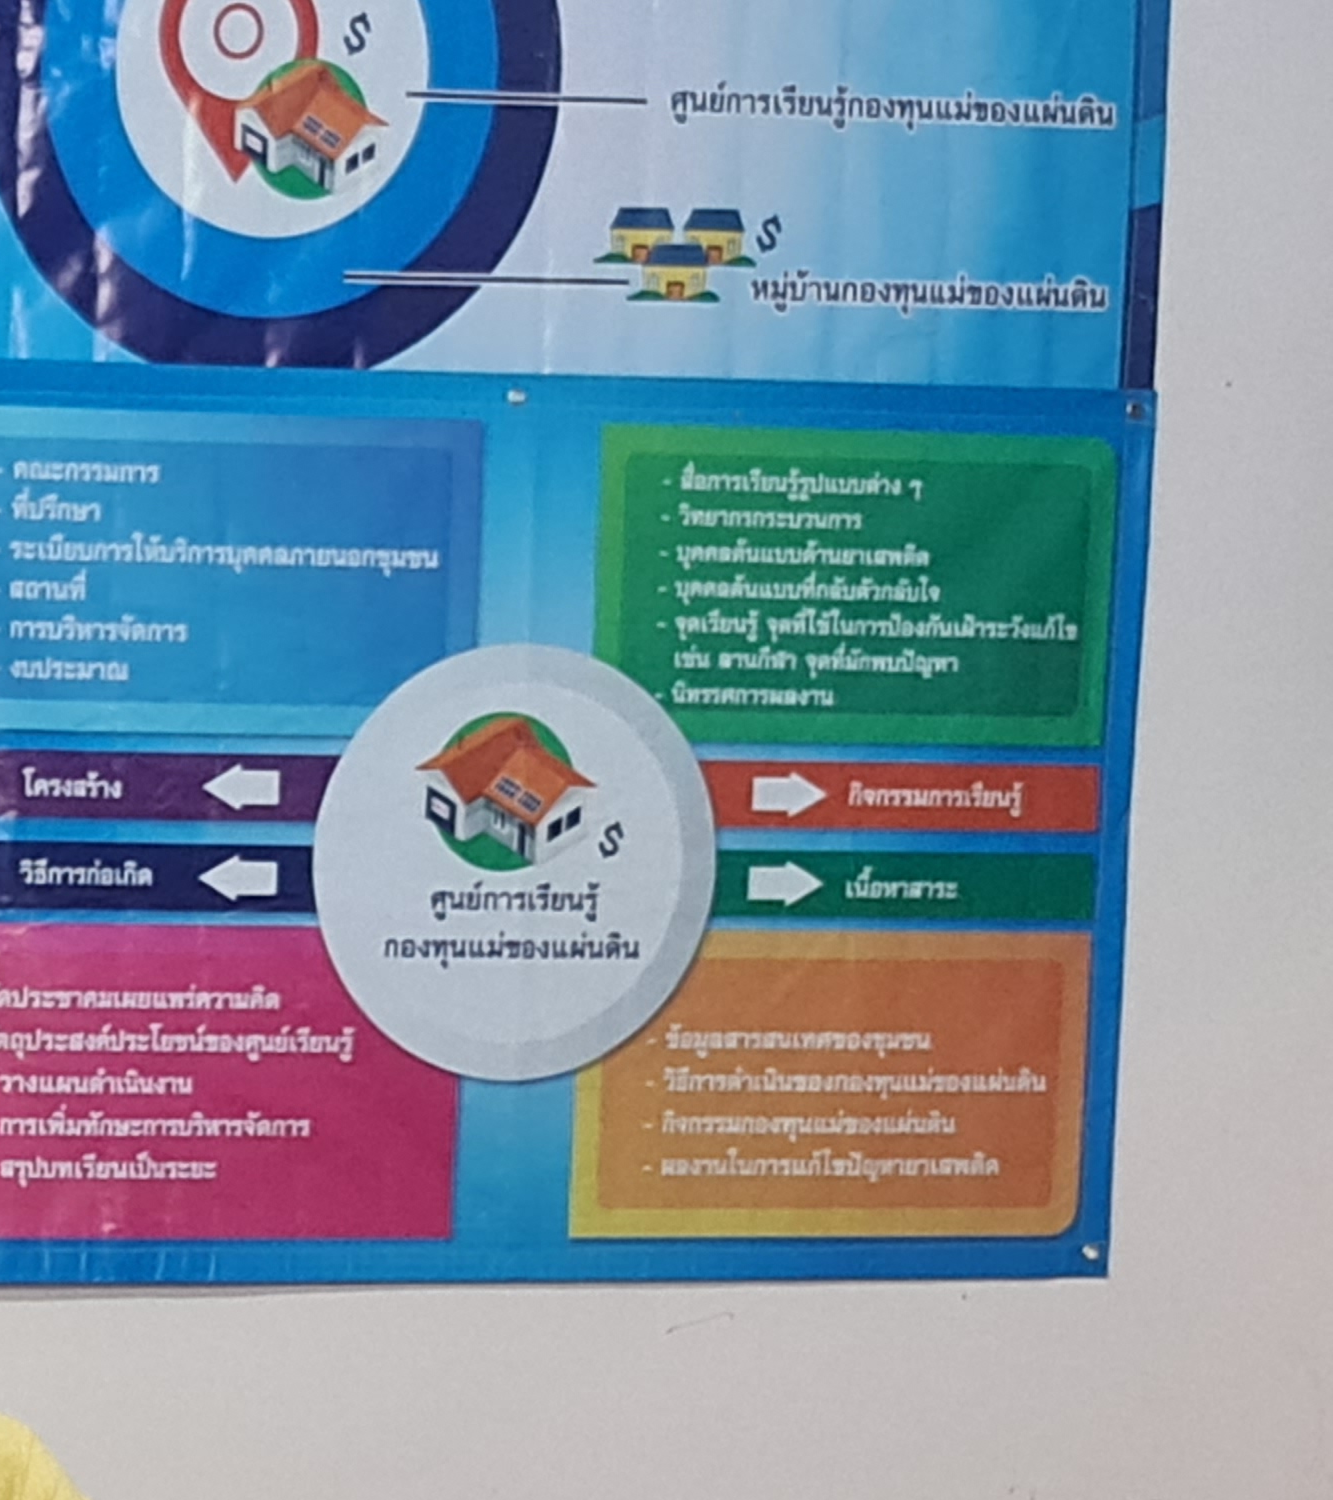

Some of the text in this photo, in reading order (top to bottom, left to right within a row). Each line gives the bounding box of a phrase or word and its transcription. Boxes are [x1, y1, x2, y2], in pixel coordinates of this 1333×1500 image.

[671, 82, 1114, 129] ศูนย์การเรียนรู้กองทุนแม่ของแผ่นดิน
[751, 270, 1107, 313] หมู่บ้านกองทุนแม่ของแผ่นดิน
[13, 460, 160, 483] คณะกรรมการ
[11, 487, 101, 521] ที่ปรึกษา
[10, 568, 86, 600] สถานที่
[10, 614, 188, 642] การบริหารจัดการ
[10, 657, 129, 681] งบประมาณ
[23, 769, 123, 801] โครงสร้าง
[848, 780, 1024, 818] กิจกรรมการเรียนรู้
[19, 857, 153, 888] วิธีการก่อเกิด
[845, 865, 959, 899] เนื้อหาสาระ
[431, 881, 599, 922] ศูนย์การเรียนรู้
[384, 932, 640, 971] กองทุนแม่ของแผ่นดิน
[0, 1150, 217, 1187] สรุปบทเรียนเป็นระยะ
